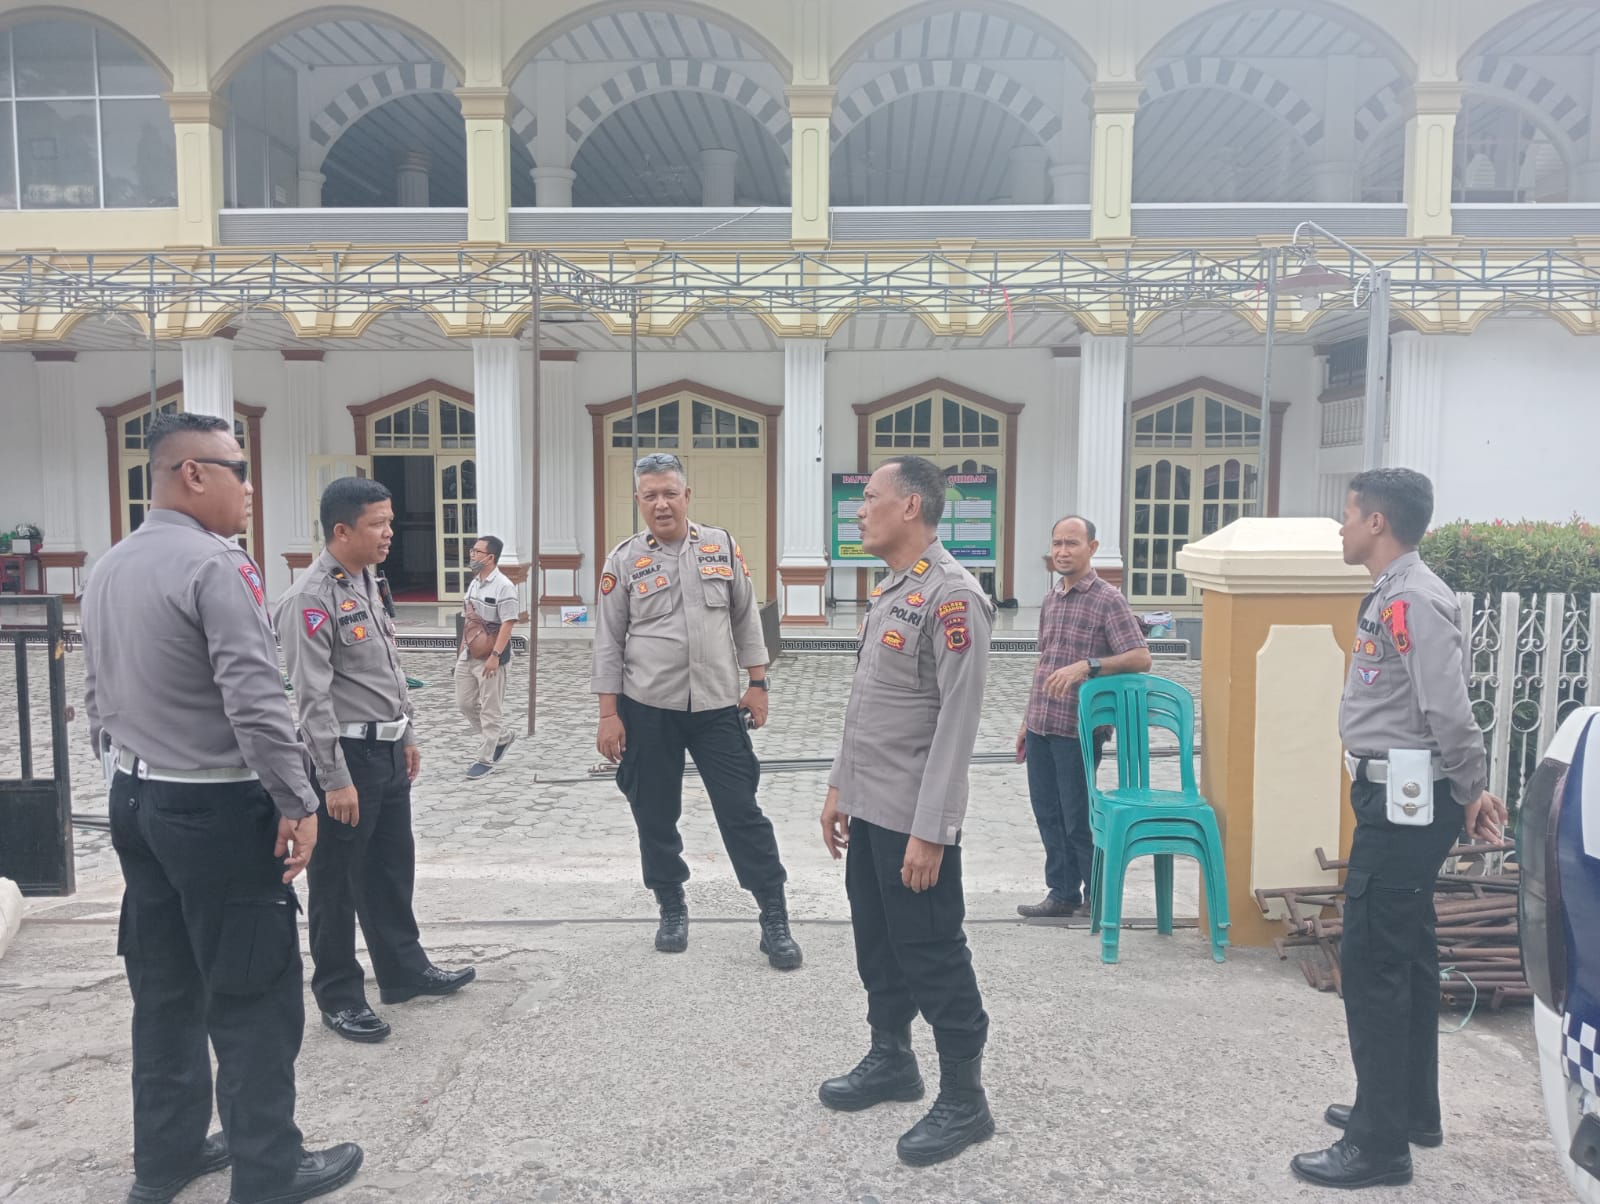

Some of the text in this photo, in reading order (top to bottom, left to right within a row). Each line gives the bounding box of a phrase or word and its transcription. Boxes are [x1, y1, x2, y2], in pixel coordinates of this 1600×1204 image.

[843, 475, 870, 483] DAFTA
[698, 555, 728, 563] POLRI
[889, 606, 923, 626] POLRI
